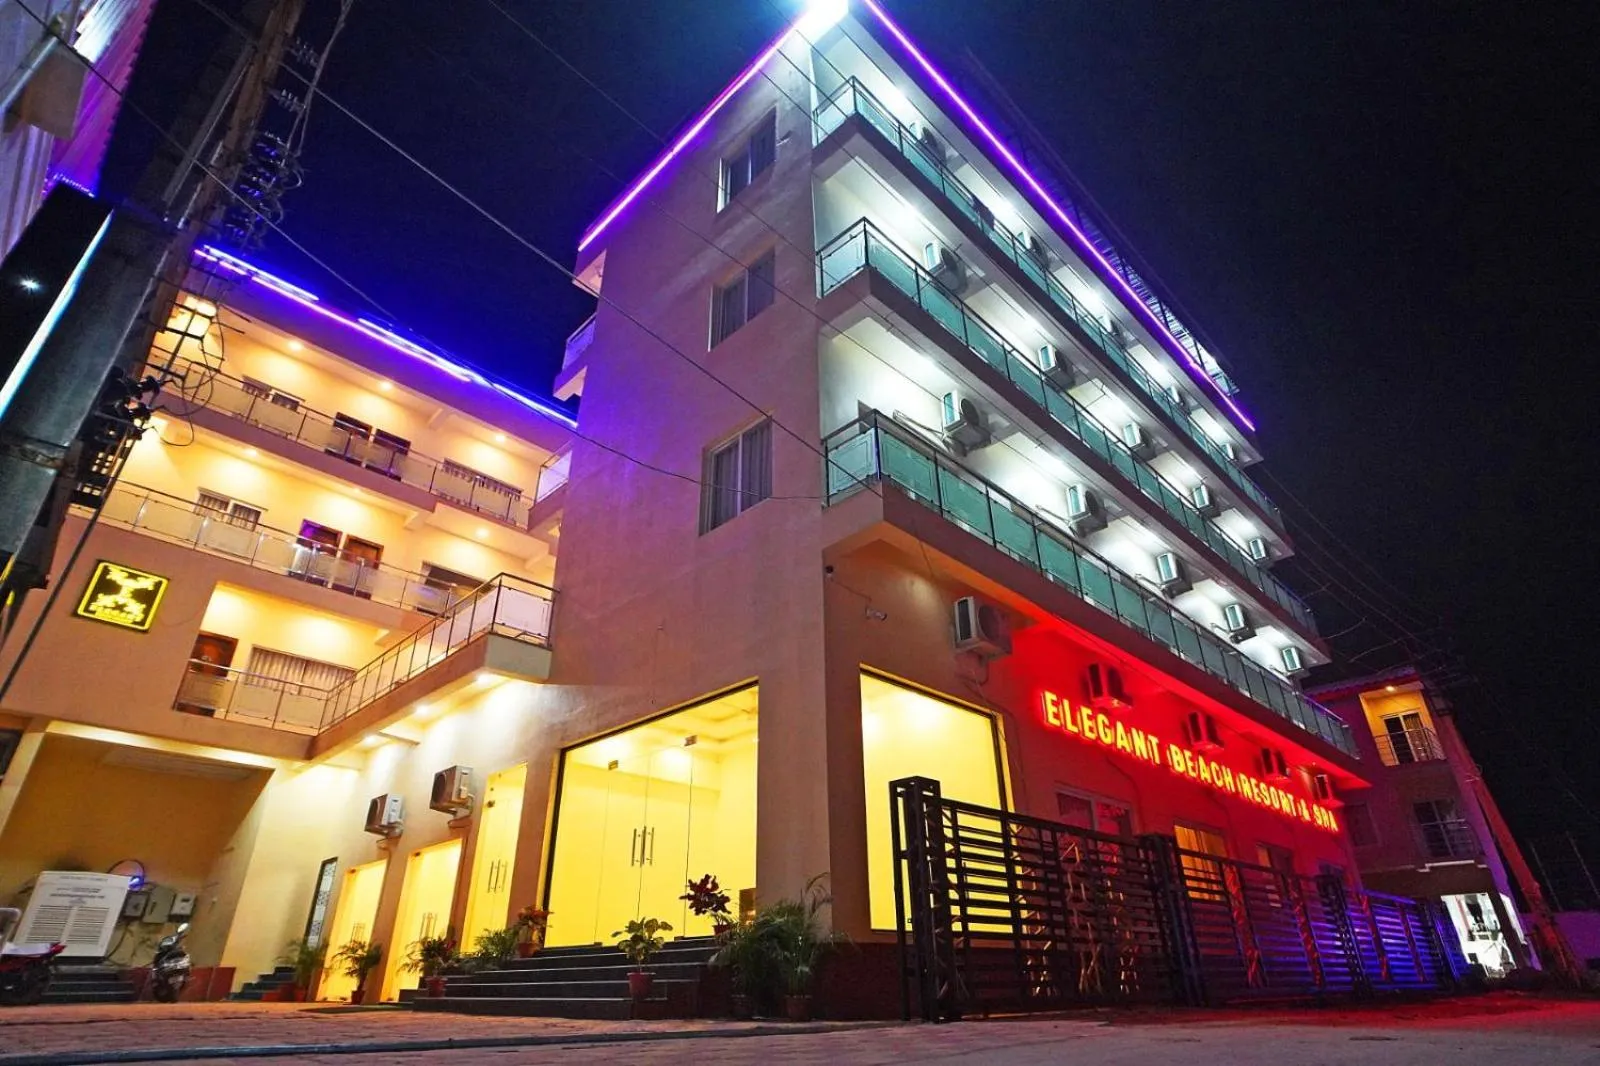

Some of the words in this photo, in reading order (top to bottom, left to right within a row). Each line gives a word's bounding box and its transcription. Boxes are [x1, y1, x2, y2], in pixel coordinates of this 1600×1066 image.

[1042, 691, 1160, 765] ELEGANT
[1167, 743, 1236, 793] BEACH
[1236, 773, 1298, 818] RESORT
[1311, 803, 1339, 832] SPA
